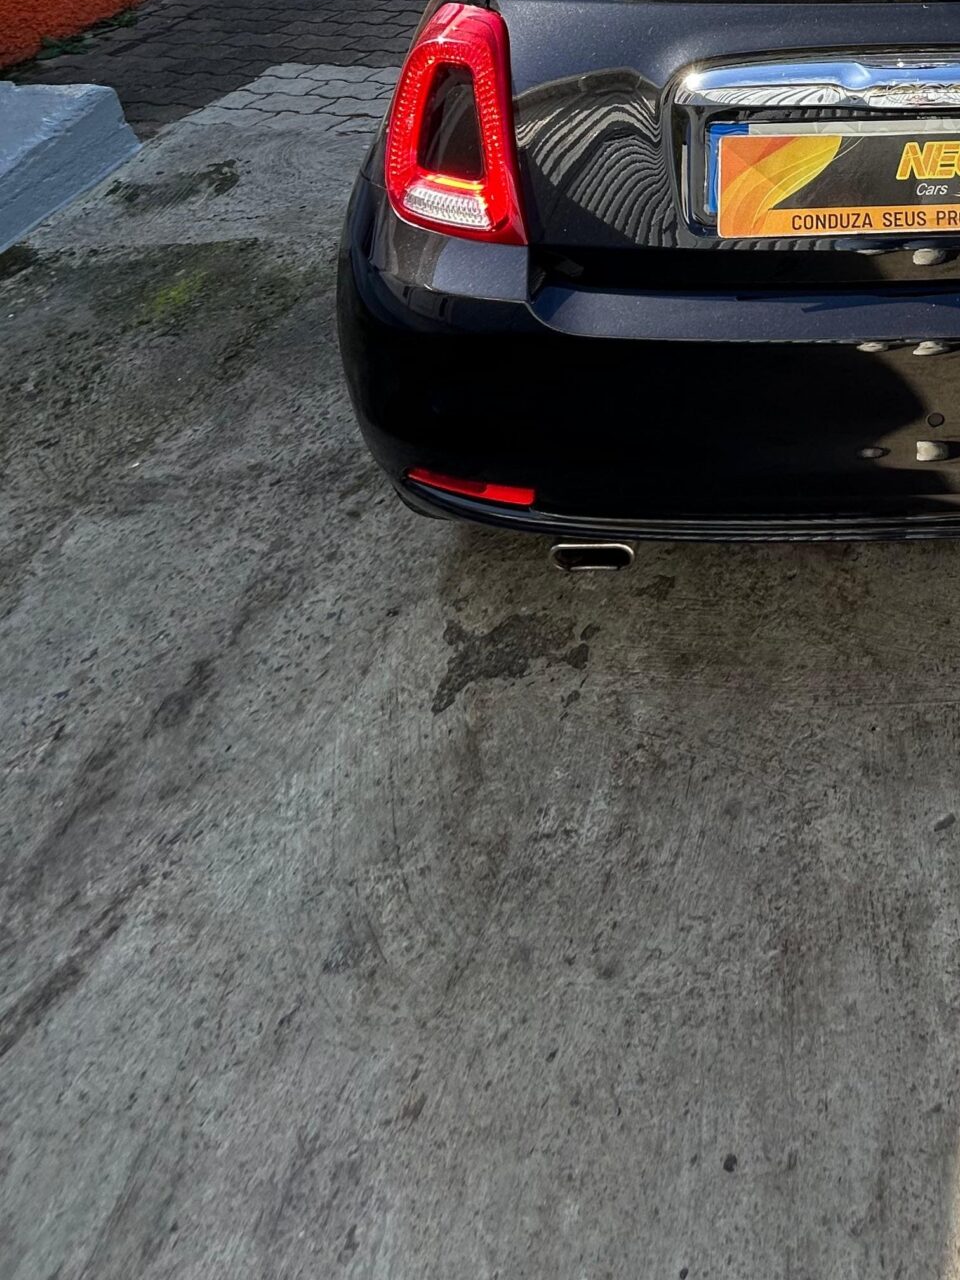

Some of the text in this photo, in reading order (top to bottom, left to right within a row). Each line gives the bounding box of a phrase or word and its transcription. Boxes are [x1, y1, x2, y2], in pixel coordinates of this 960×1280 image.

[916, 182, 949, 196] Cars
[792, 212, 873, 231] CONDUZA
[882, 210, 927, 228] SEUS
